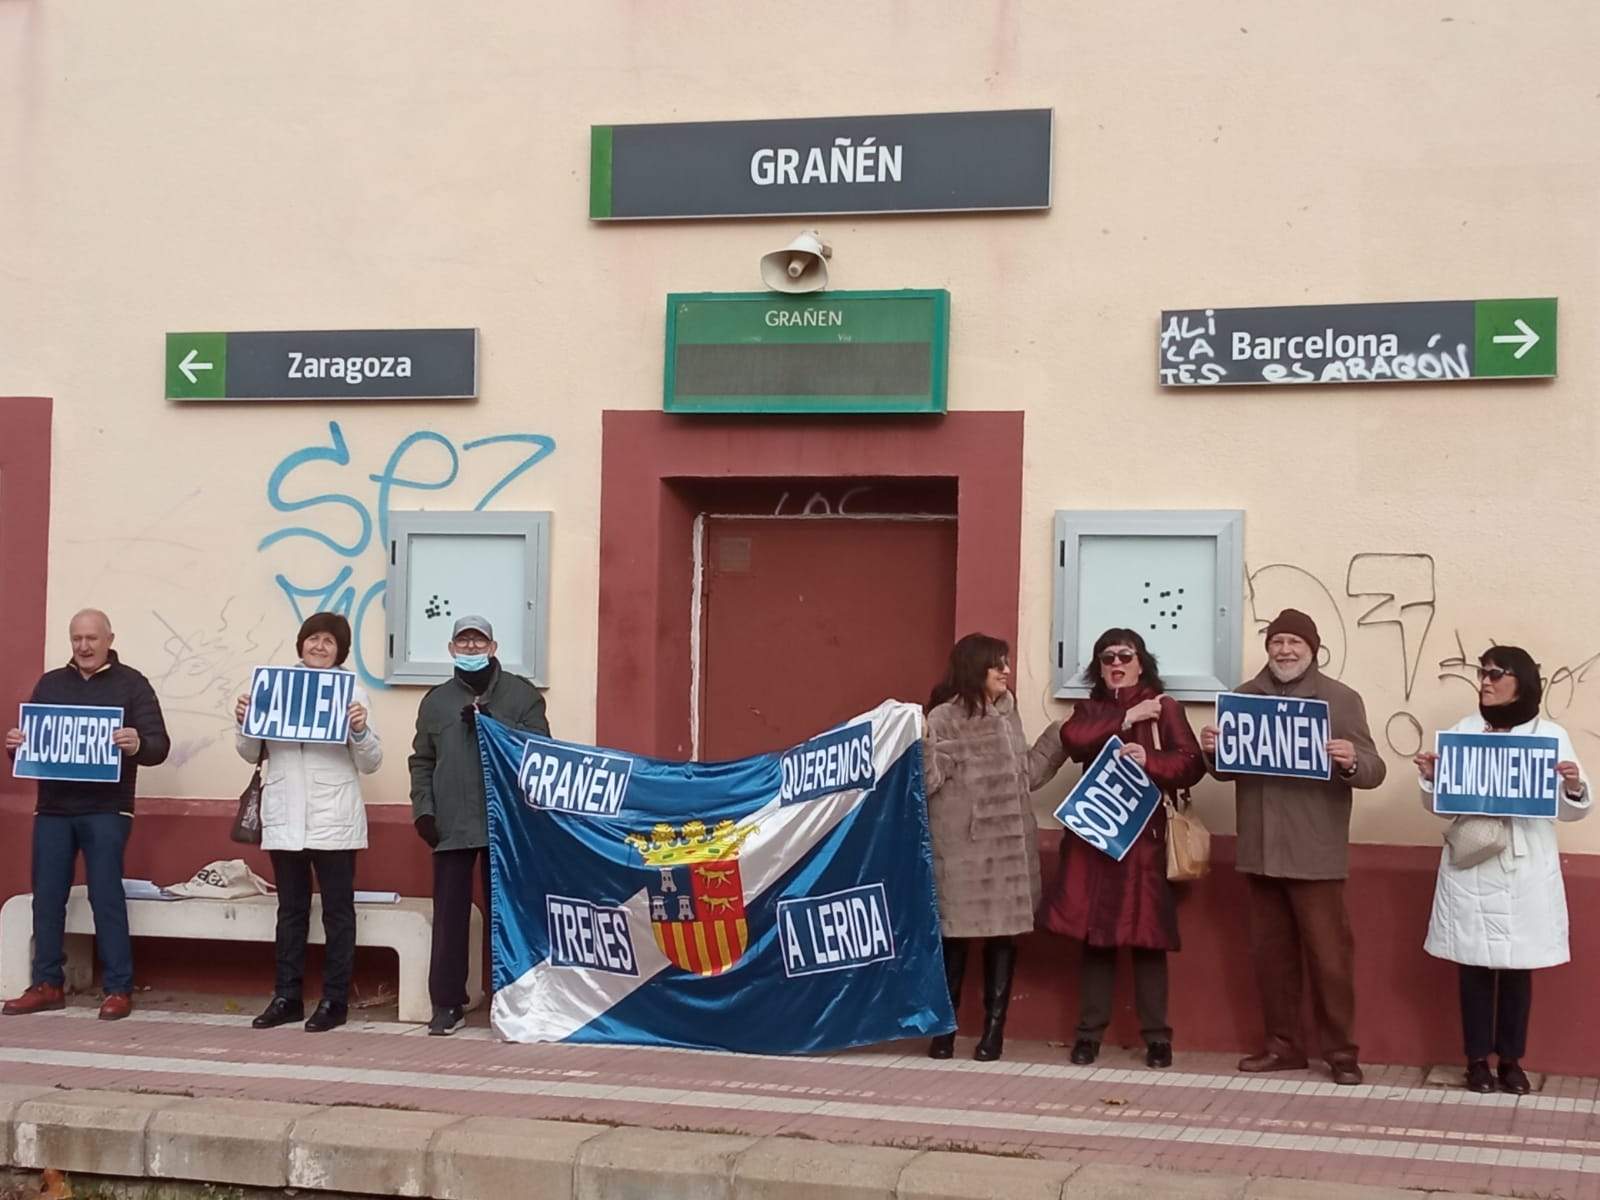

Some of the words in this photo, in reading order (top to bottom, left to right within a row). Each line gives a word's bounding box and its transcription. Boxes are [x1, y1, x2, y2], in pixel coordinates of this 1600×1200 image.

[750, 136, 904, 186] GRAÑÉN
[765, 308, 843, 327] GRAÑEN
[1232, 328, 1398, 361] Barcelona
[288, 352, 412, 384] Zaragoza
[249, 669, 350, 740] CALLEN
[17, 716, 120, 765] ALCUBIERRE
[1218, 700, 1328, 772] GRAÑÉN
[520, 753, 626, 812] GRAÑÉN
[780, 735, 873, 799] QUEREMOS
[1436, 747, 1556, 798] ALMUNIENTE
[1064, 749, 1151, 850] SODETO
[549, 904, 632, 972] TRENES
[786, 915, 806, 970] A
[811, 895, 888, 966] LERIDA
